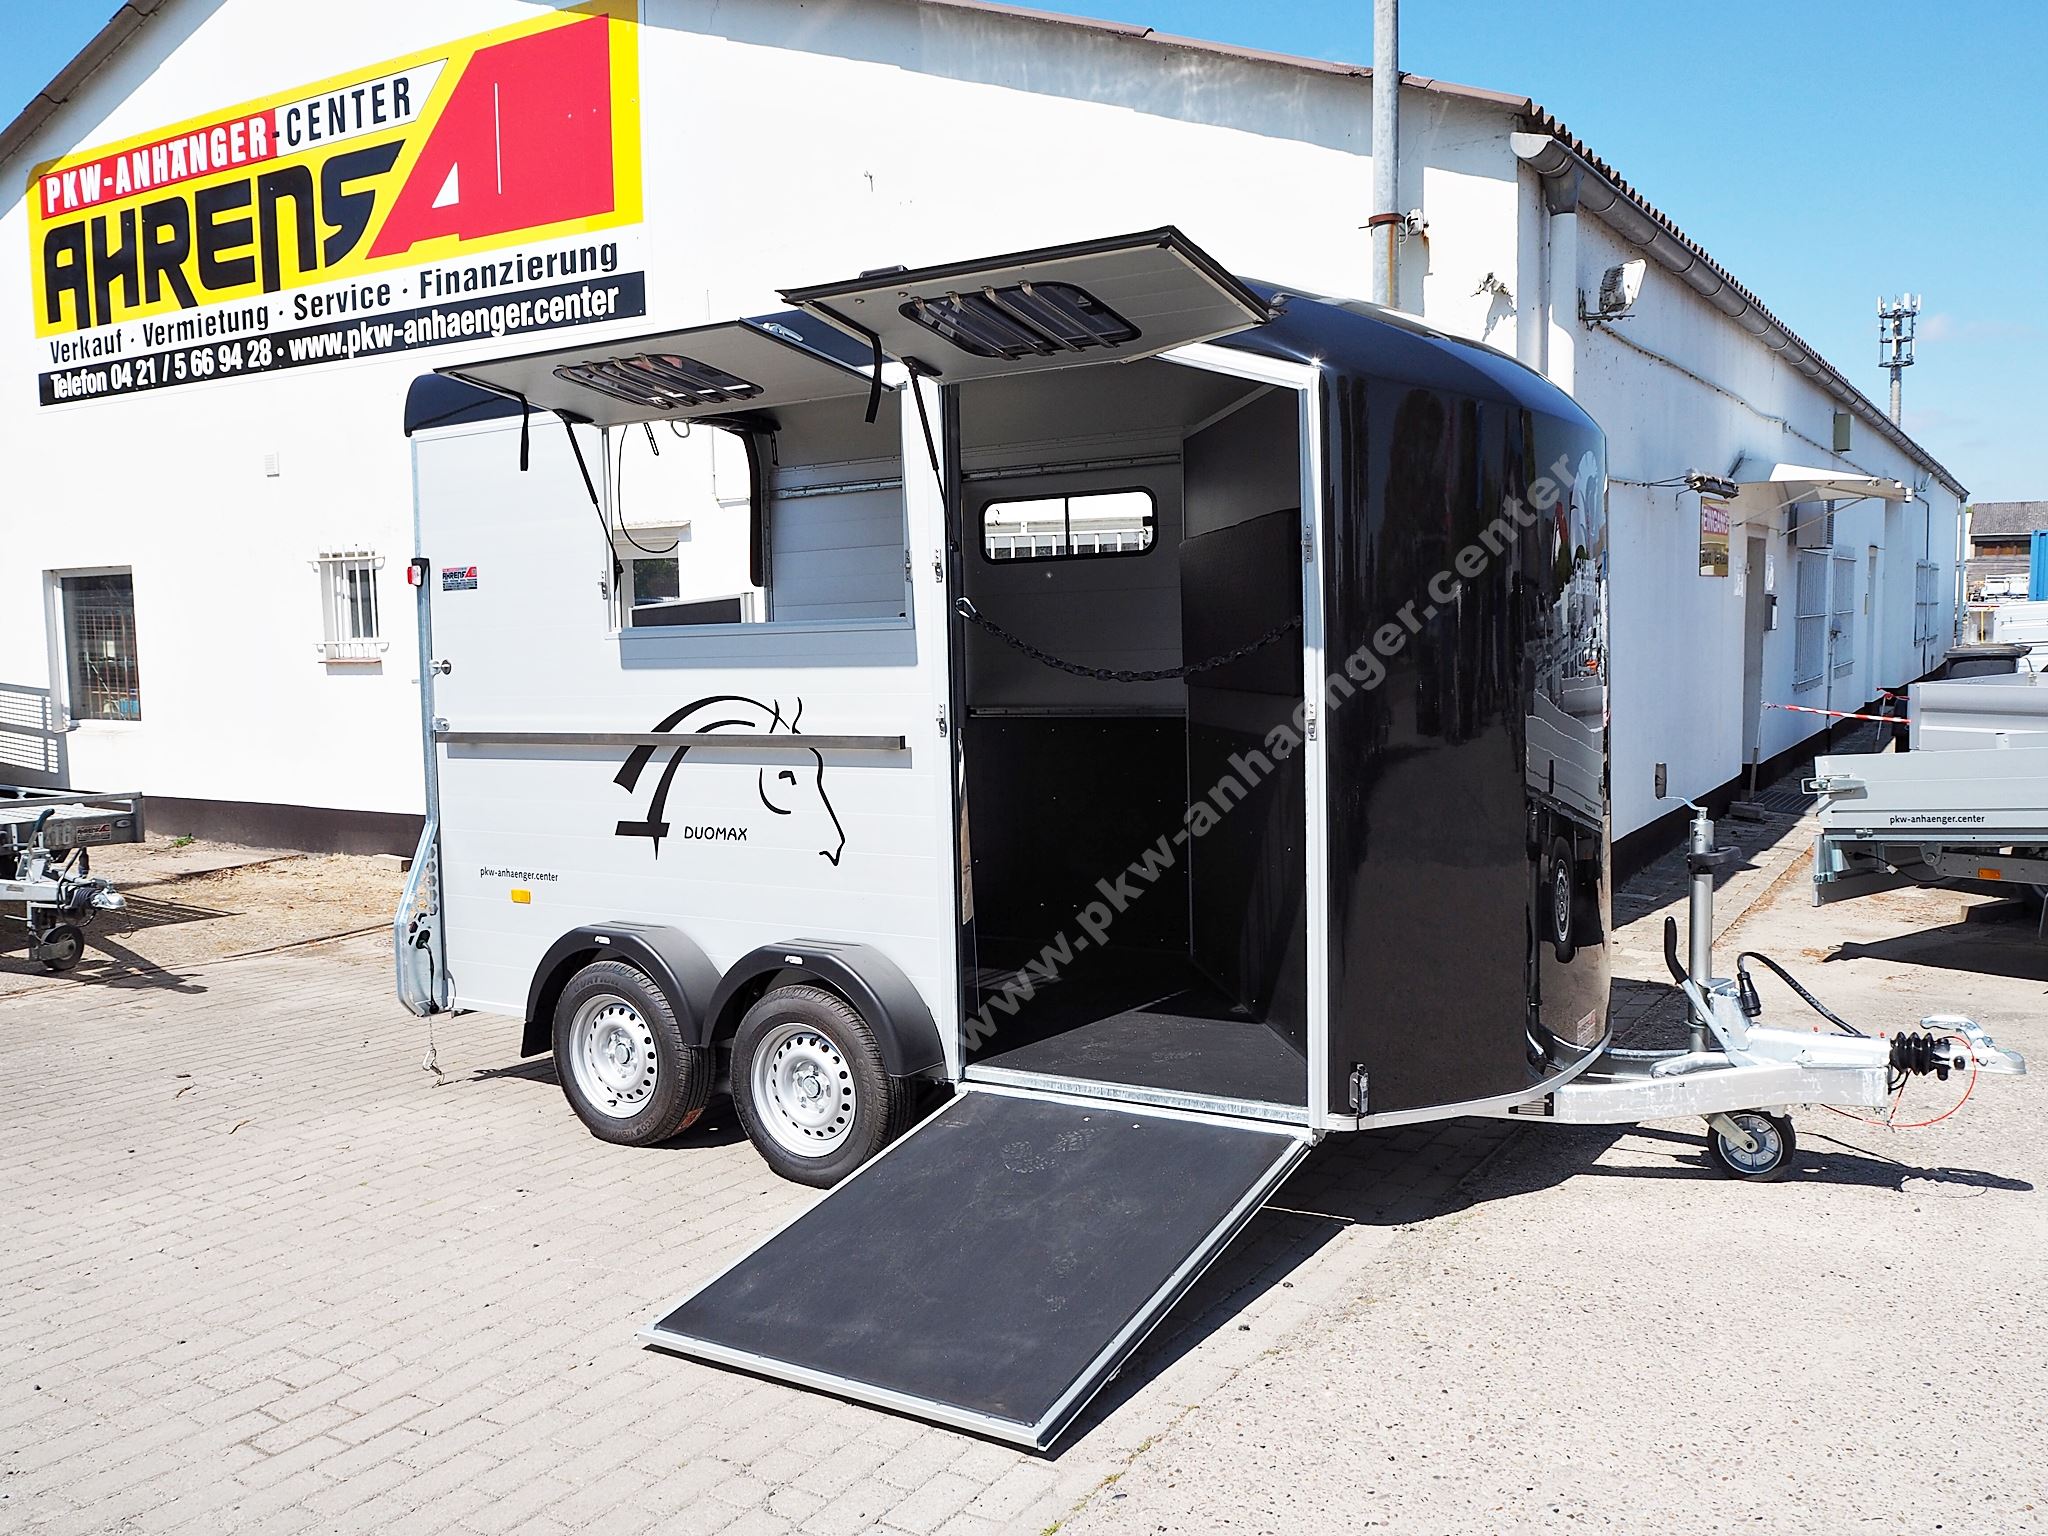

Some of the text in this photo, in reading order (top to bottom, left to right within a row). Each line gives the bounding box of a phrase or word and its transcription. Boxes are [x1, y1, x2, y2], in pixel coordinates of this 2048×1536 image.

[43, 140, 406, 330] AHRENS
[50, 242, 618, 364] Verkauf Vermietung Service Finanzierung
[50, 372, 107, 399] Telefon
[110, 362, 133, 389] 04
[136, 357, 157, 386] 21
[174, 352, 187, 380] 5
[190, 347, 215, 377] 66
[218, 341, 243, 373] 94
[247, 338, 273, 368] 28
[289, 284, 619, 361] www.pkw-anhaenger.center
[684, 826, 748, 841] DUOMAX
[1889, 814, 1985, 825] pkw-anhaenger.center
[480, 867, 558, 882] pkw-anhaenger.center
